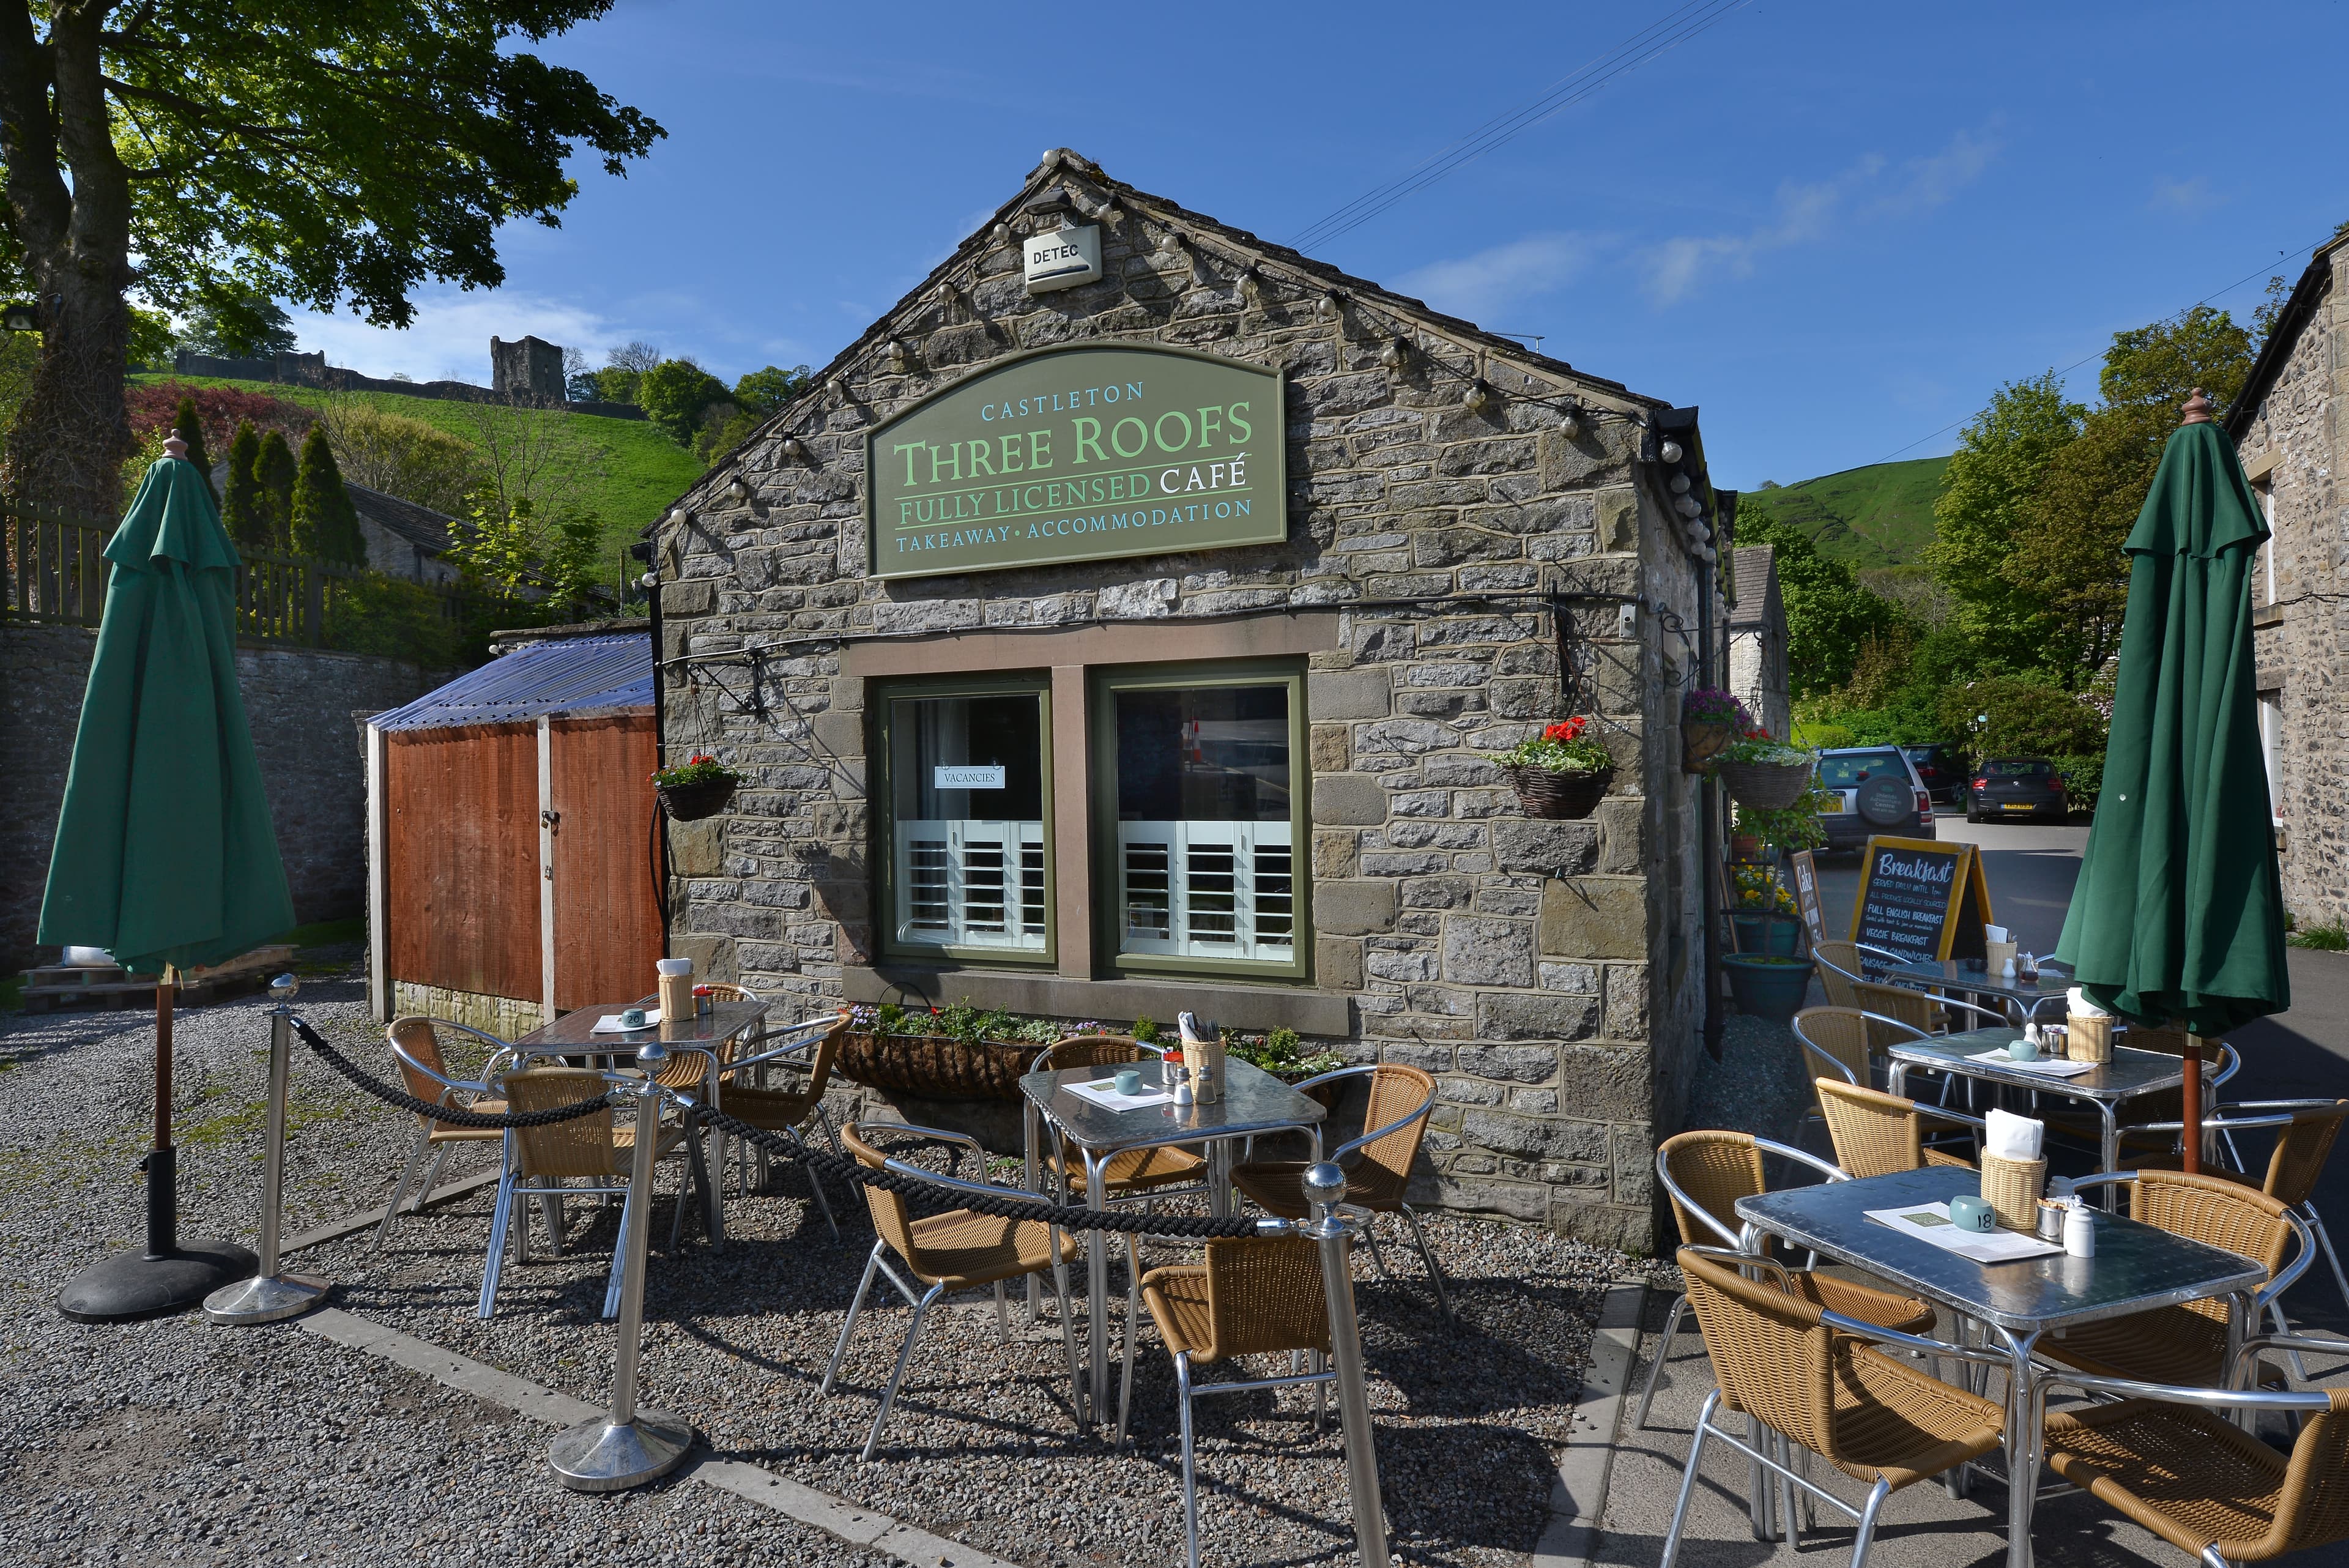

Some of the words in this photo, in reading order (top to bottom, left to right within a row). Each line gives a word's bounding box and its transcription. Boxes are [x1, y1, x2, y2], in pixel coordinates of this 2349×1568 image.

[1033, 244, 1078, 264] DETEC
[981, 381, 1144, 422] CASTLETON
[894, 428, 1054, 487] THREE
[1071, 401, 1252, 465] ROOFS
[900, 492, 986, 525] FULLY
[995, 473, 1151, 514] LICENSED
[1160, 451, 1247, 494] CAFÉ
[896, 525, 1011, 553] TAKEAWAY
[1027, 499, 1252, 539] ACCOMMODATION
[944, 773, 995, 782] VACANCIES
[1879, 853, 1954, 882] Breakfast
[1797, 864, 1813, 893] Cake
[1873, 877, 1894, 888] SERVED
[1913, 884, 1929, 894] UNTIL
[1882, 893, 1902, 902] PRODUCE
[1903, 896, 1923, 905] LOCALLY
[1868, 904, 1883, 915] FULL
[1887, 907, 1910, 920] ENGLISH
[1912, 912, 1944, 924] BREAKFAST
[1866, 927, 1890, 939] VEGGIE
[1891, 932, 1929, 946] BREAKFAST
[1890, 948, 1933, 963] SANDWICHES
[627, 1015, 640, 1024] 20
[1977, 1213, 1992, 1228] 18
